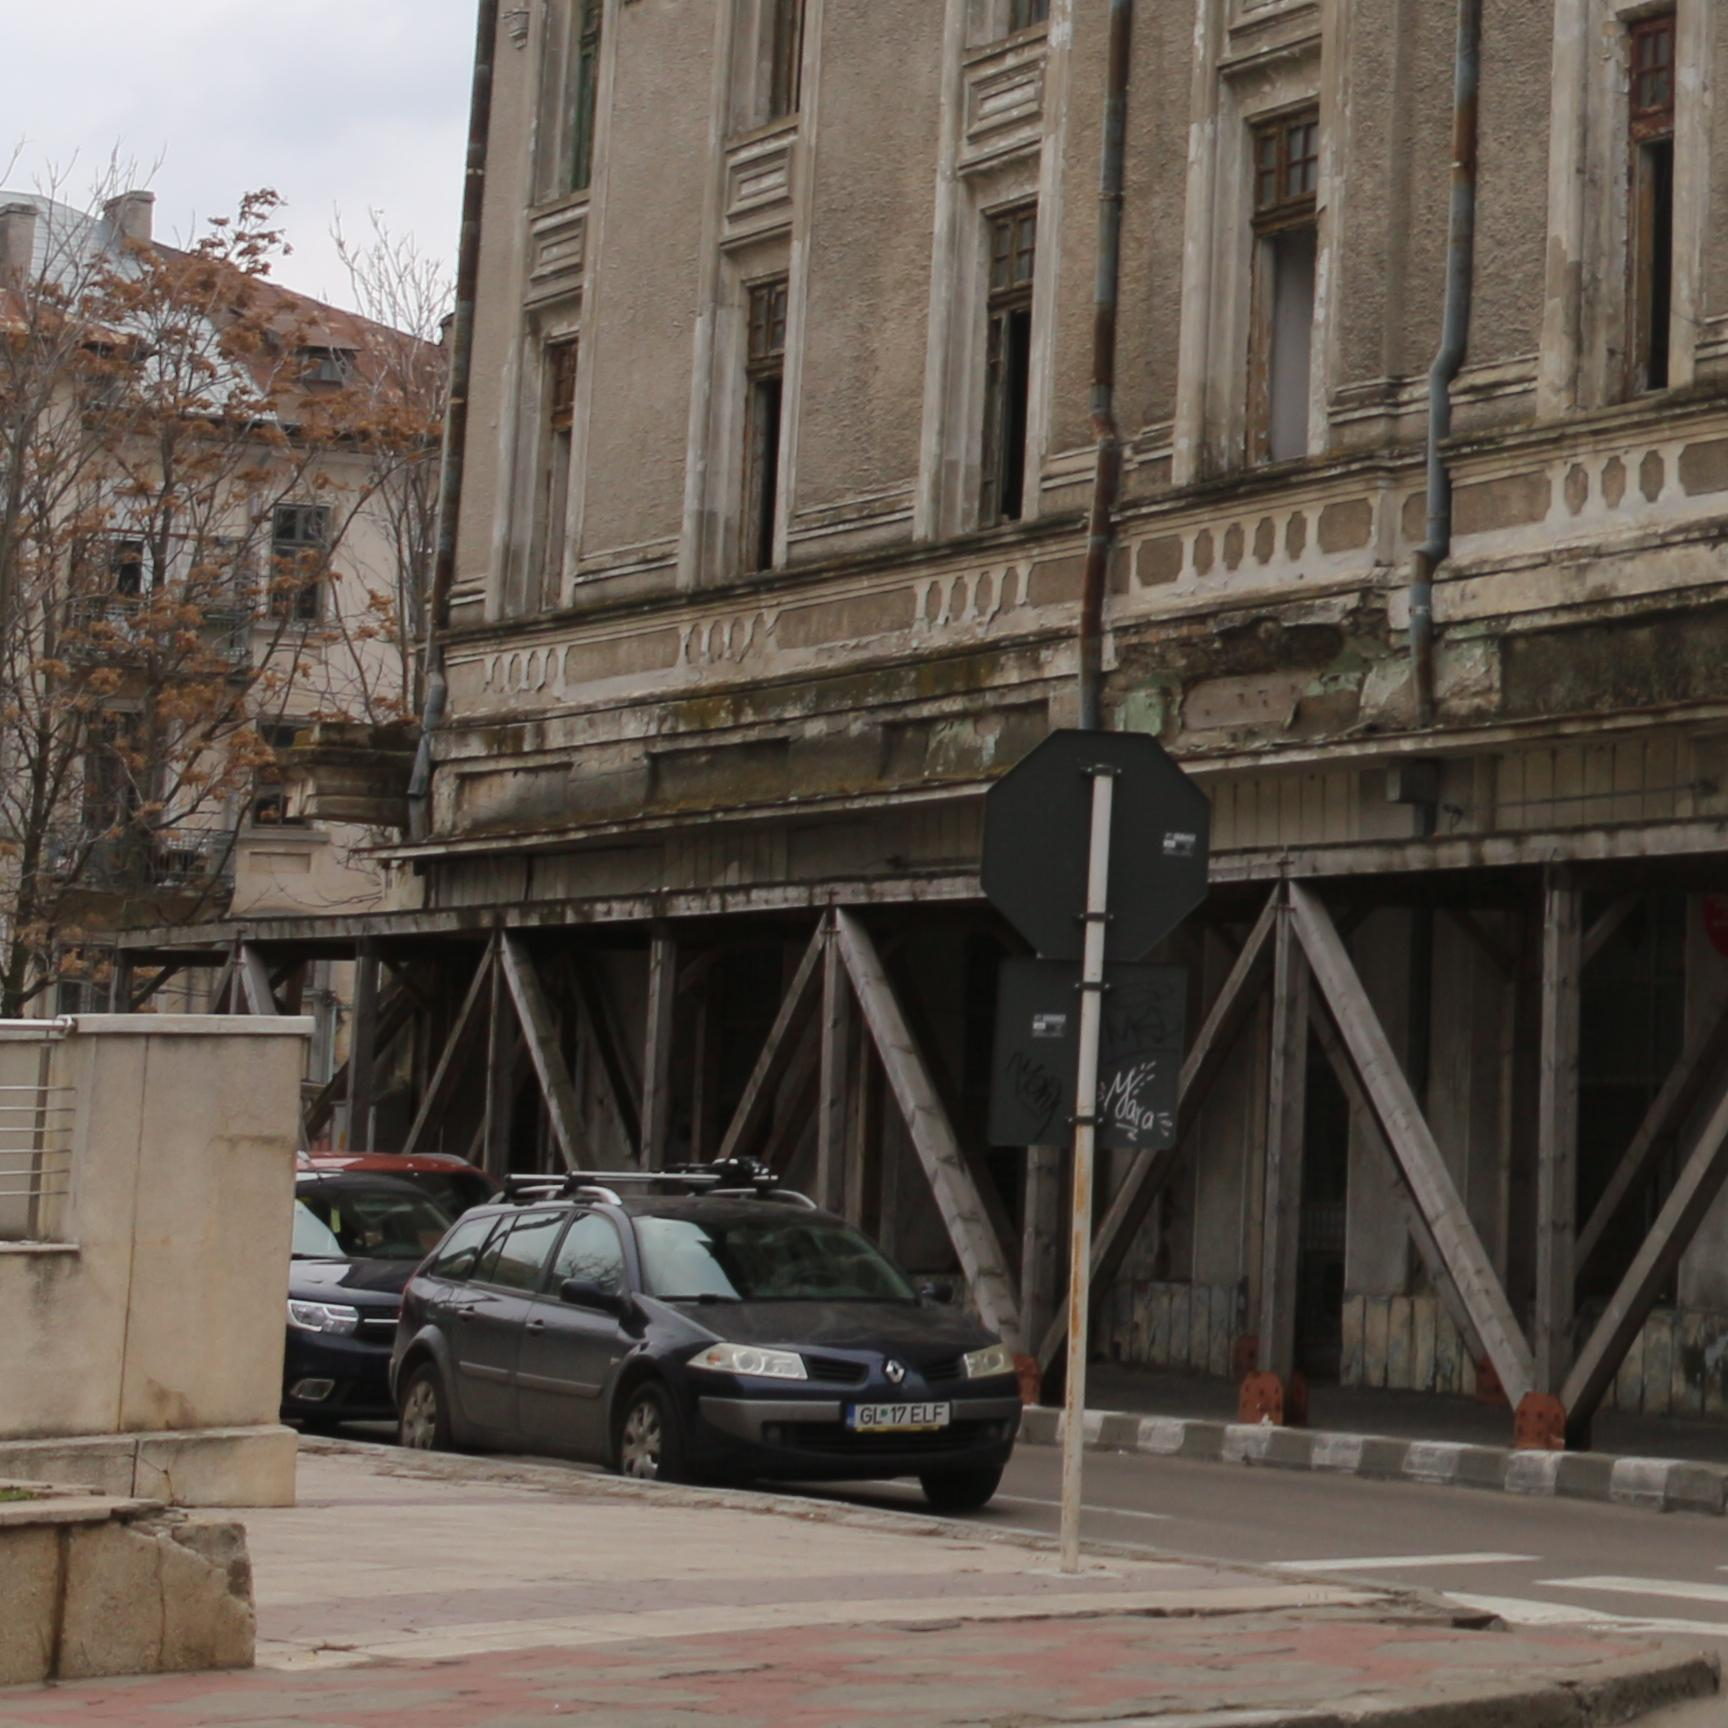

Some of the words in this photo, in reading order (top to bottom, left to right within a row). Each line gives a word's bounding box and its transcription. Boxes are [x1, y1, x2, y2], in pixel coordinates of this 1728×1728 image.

[860, 1406, 882, 1425] GL
[890, 1405, 907, 1424] 17
[910, 1404, 945, 1424] ELF
